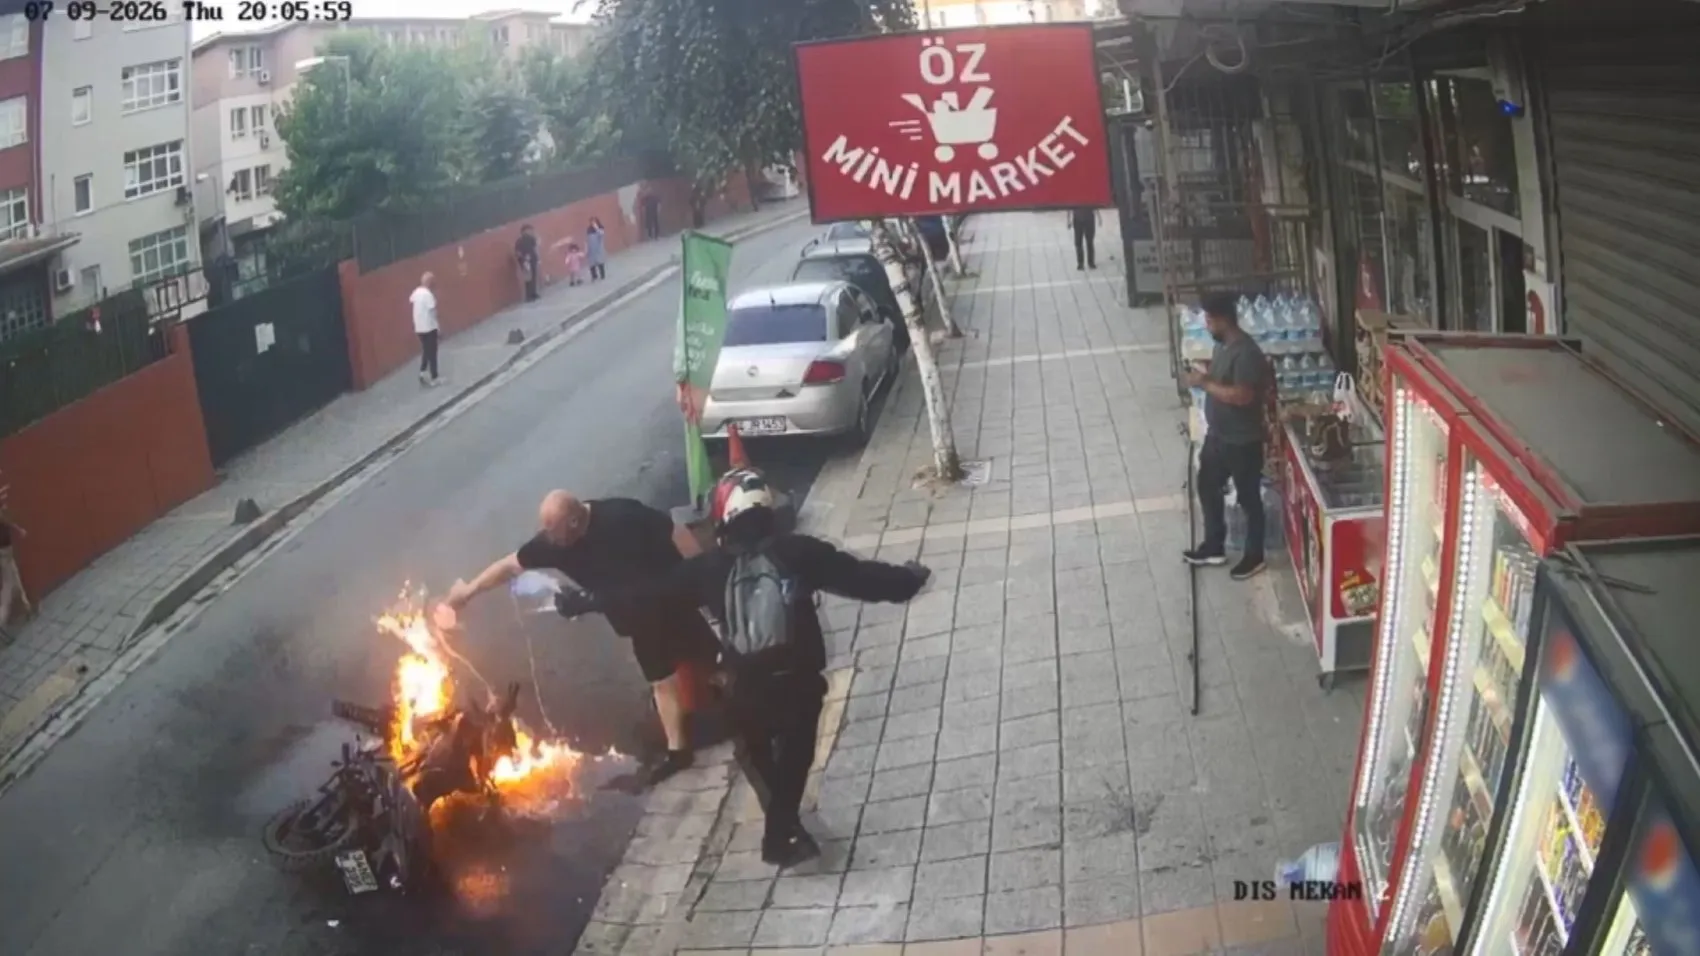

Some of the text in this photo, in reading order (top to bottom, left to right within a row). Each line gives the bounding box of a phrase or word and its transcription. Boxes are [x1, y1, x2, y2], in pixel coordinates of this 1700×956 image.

[919, 36, 991, 85] ÖZ
[821, 115, 1089, 204] MİNİ MARKET
